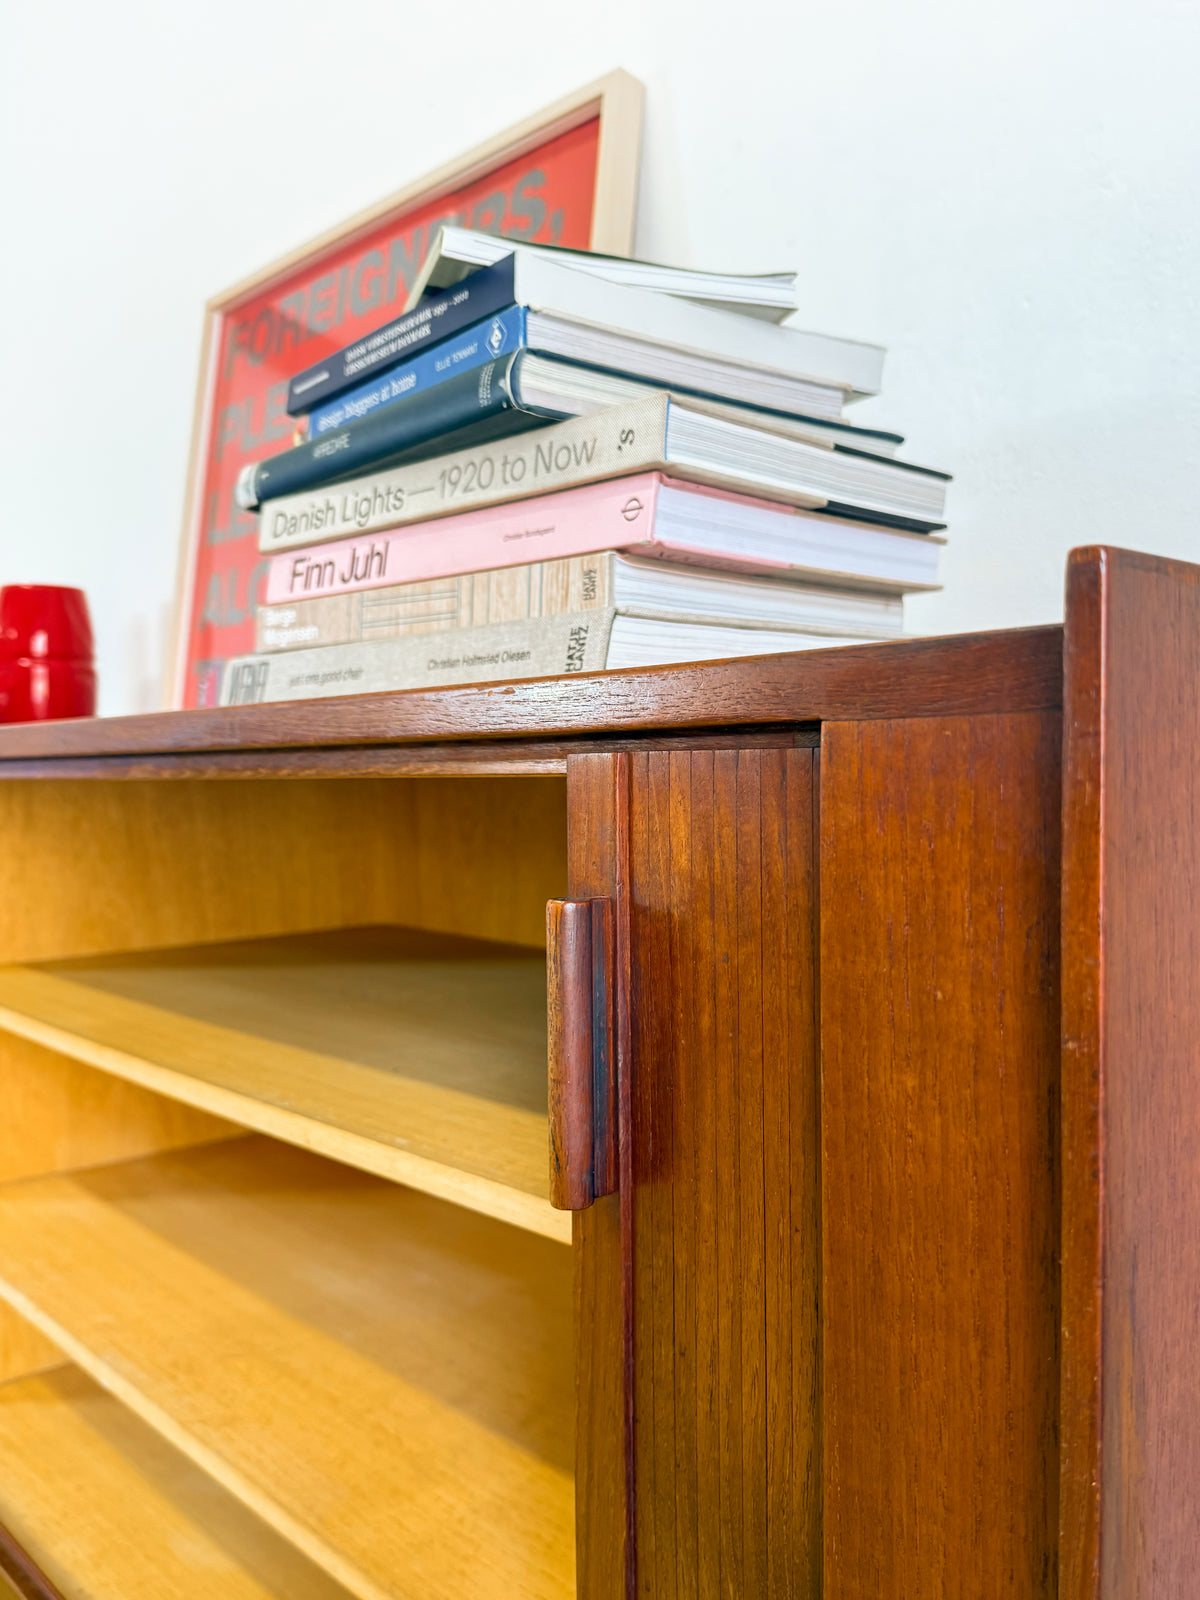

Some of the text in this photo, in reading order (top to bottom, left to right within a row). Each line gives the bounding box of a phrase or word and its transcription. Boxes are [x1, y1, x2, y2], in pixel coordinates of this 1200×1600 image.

[217, 168, 565, 381] FOREIGNRS,
[216, 378, 292, 462] PLE
[272, 501, 335, 539] Danish
[502, 453, 527, 479] to
[533, 436, 596, 476] Now
[289, 541, 391, 594] Finn Juhl
[501, 650, 532, 662] Olesen
[565, 627, 580, 672] HATJE
[573, 624, 589, 672] CANTZ
